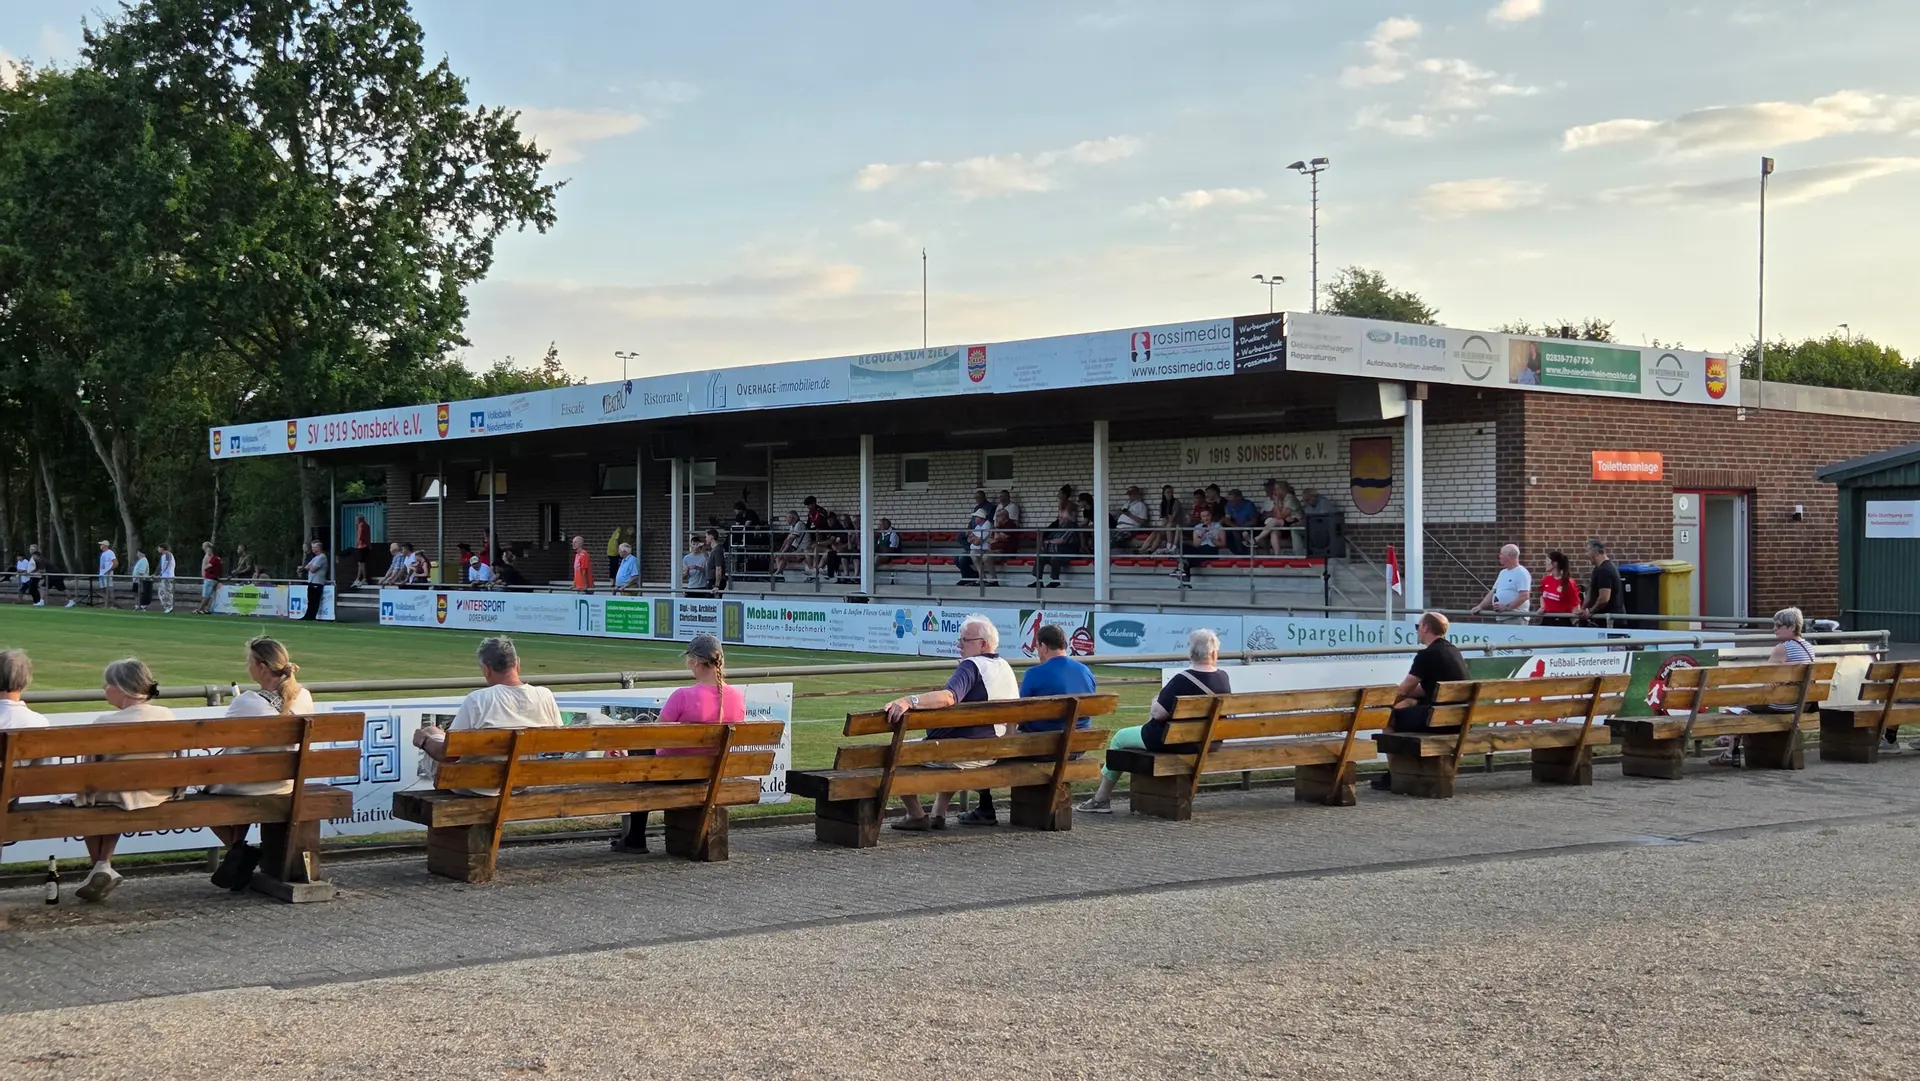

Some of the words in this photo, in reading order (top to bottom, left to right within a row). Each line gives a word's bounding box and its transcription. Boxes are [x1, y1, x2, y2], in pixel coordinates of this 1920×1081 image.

[1153, 323, 1231, 346] rossimedia
[1393, 331, 1446, 348] Janßen
[1290, 351, 1337, 362] Reparaturen
[1366, 359, 1398, 369] Autohaus
[1131, 357, 1231, 377] www.rossimedia.de
[560, 400, 585, 416] Eiscafé
[643, 391, 683, 406] Ristorante
[307, 423, 320, 444] SV
[323, 420, 348, 443] 1919
[351, 414, 400, 441] Sonsbeck
[403, 412, 423, 436] e.V.
[1186, 449, 1200, 465] SV
[1208, 448, 1231, 465] 1919
[1236, 443, 1299, 463] SONSBECK
[1304, 441, 1327, 461] e.V.
[1597, 460, 1659, 475] Toilettenanlage
[462, 599, 507, 613] INTERSPORT
[747, 607, 778, 620] Mobau
[780, 608, 826, 623] Hopmann
[941, 610, 971, 619] Bauzentru
[746, 622, 780, 631] Bauzentrum
[785, 623, 826, 633] Baufachmarkt
[1287, 622, 1385, 648] Spargelhof
[1549, 656, 1621, 669] Fußball-Förderverein
